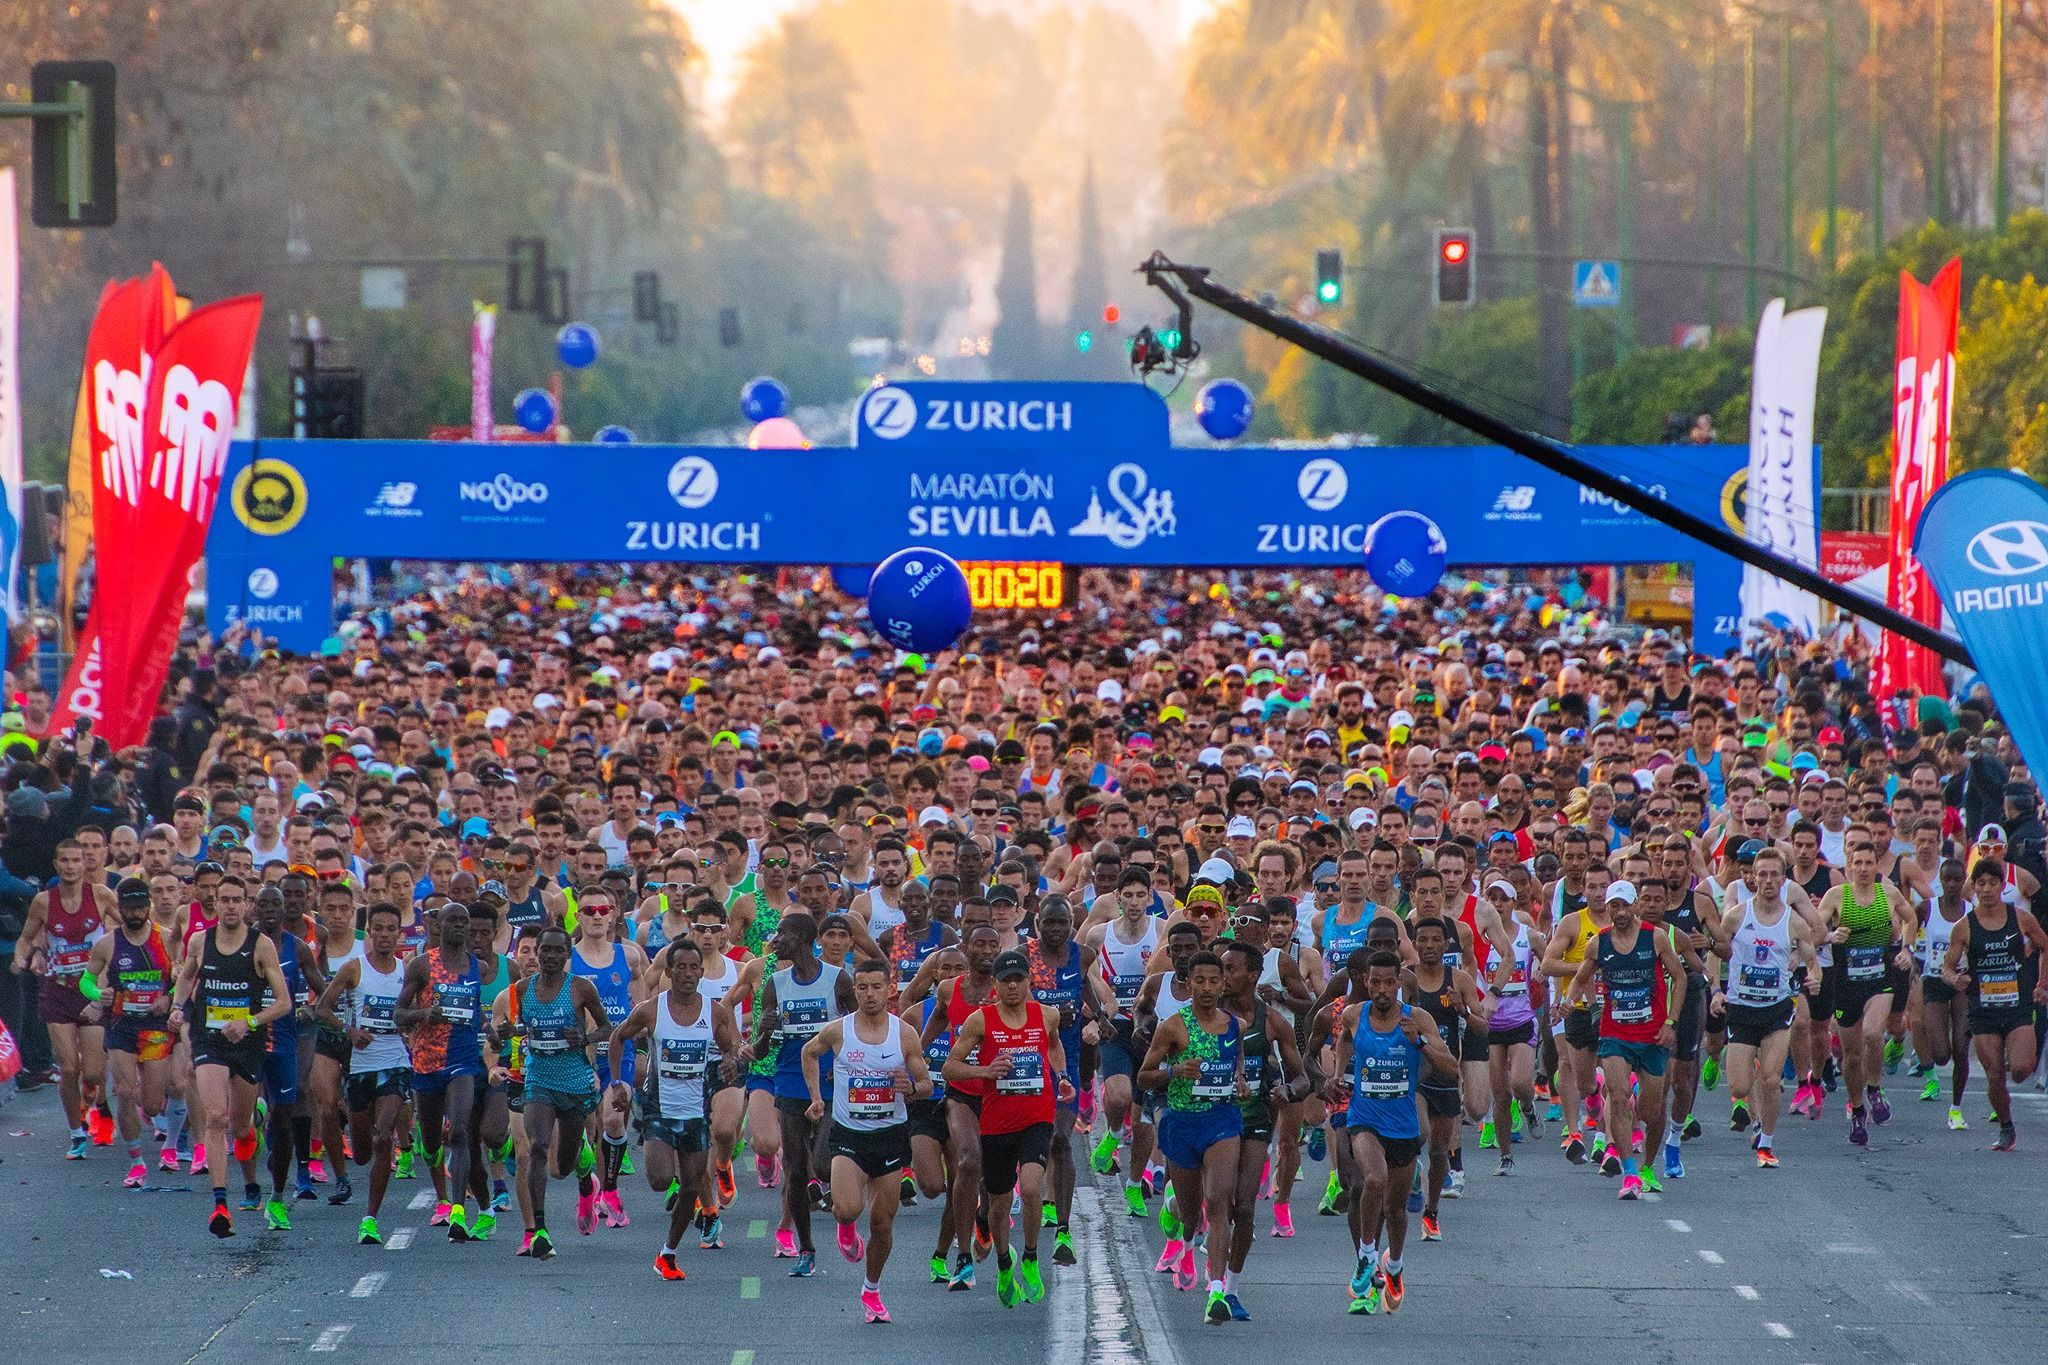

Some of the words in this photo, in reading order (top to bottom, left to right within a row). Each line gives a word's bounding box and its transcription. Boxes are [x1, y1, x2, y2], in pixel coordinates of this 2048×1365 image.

[925, 400, 1072, 431] ZURICH
[909, 468, 1055, 501] MARATÓN
[908, 506, 1056, 536] SEVILLA
[625, 521, 761, 551] ZURICH
[1255, 523, 1366, 553] ZURIC
[1826, 561, 1873, 576] ESPAÑ
[908, 563, 946, 599] ZURICH
[508, 915, 541, 923] MARATHON
[1753, 968, 1776, 976] ZURICH
[204, 979, 249, 990] Alimco
[448, 985, 473, 994] ZURICH
[1623, 990, 1646, 998] ZURICH
[599, 996, 618, 1005] AIN
[796, 1001, 821, 1009] ZURICH
[604, 1006, 626, 1015] KOA
[541, 1030, 556, 1038] 362
[677, 1041, 702, 1049] ZURICH
[1210, 1063, 1233, 1071] ZURICH
[1015, 1069, 1026, 1077] 32
[1380, 1072, 1391, 1080] 85
[865, 1093, 880, 1101] 201
